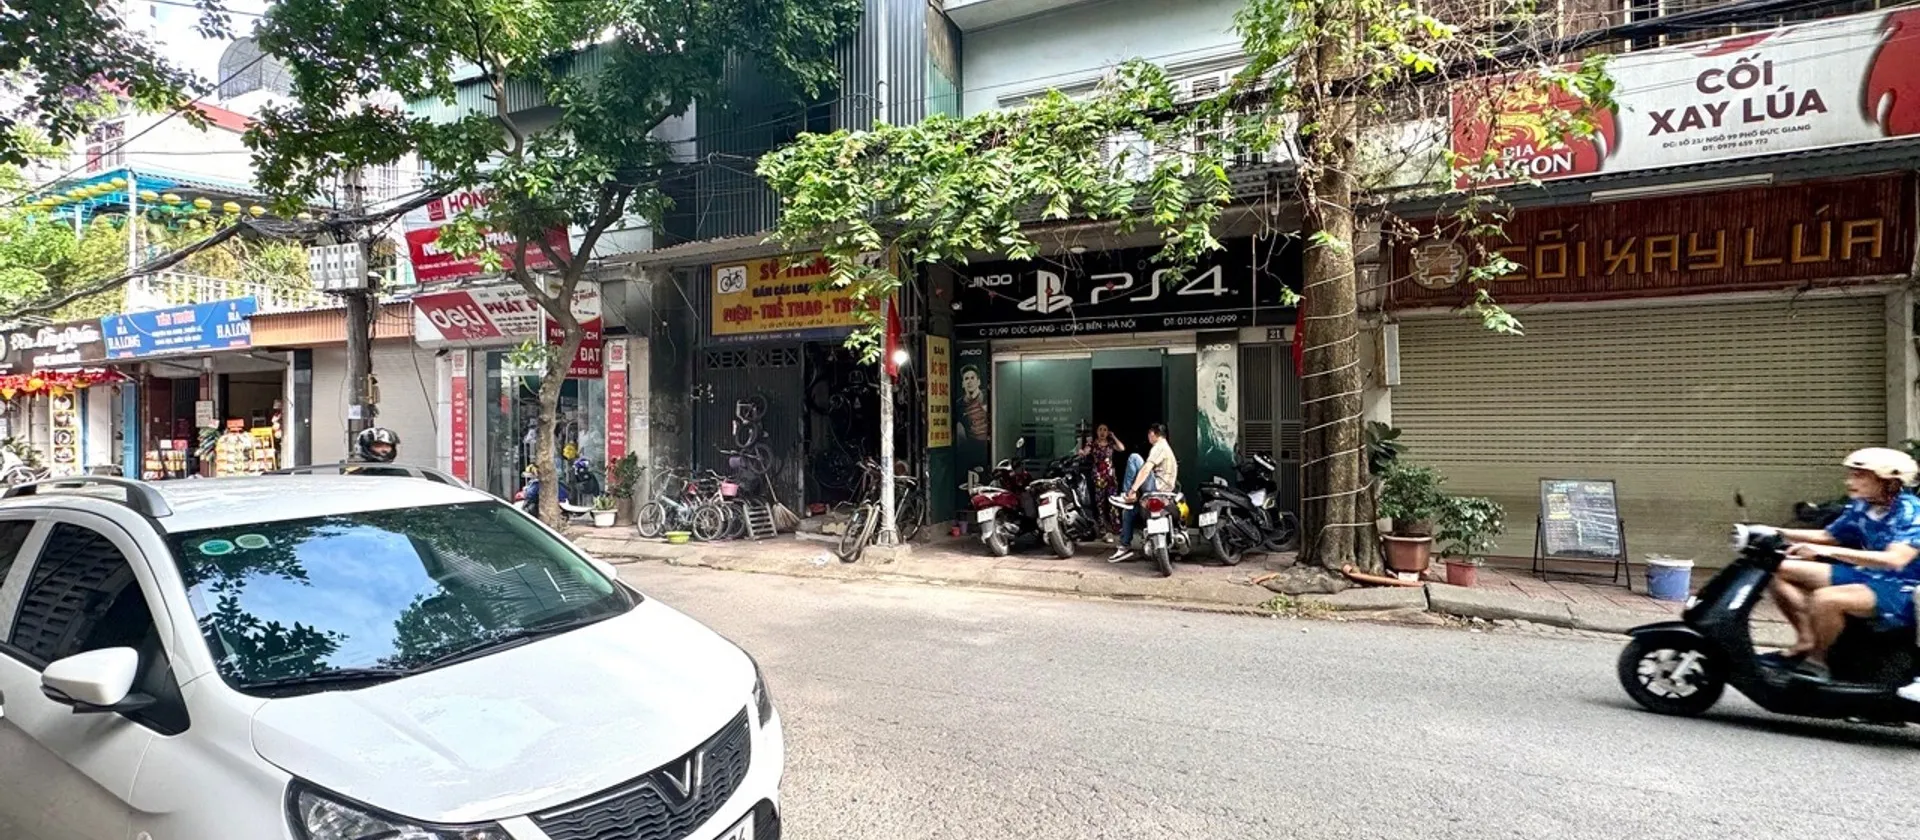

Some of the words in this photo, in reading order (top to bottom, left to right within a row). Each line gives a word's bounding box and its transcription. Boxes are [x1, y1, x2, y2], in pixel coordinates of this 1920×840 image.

[1695, 52, 1774, 95] CỐI
[1648, 101, 1730, 136] XAY
[1743, 80, 1828, 123] LÚA
[1782, 124, 1811, 134] GIANG
[1603, 229, 1725, 277] XAY
[1743, 204, 1885, 268] LÚA
[968, 274, 1012, 288] JINDO
[1090, 264, 1229, 305] PS4
[429, 304, 487, 329] deli
[786, 300, 822, 318] THAO
[1029, 325, 1056, 334] GIANG
[1060, 323, 1084, 332] LONG
[1177, 316, 1197, 325] 0124
[1216, 314, 1238, 324] 6999
[1269, 330, 1281, 339] 21
[580, 347, 600, 366] ĐẠT
